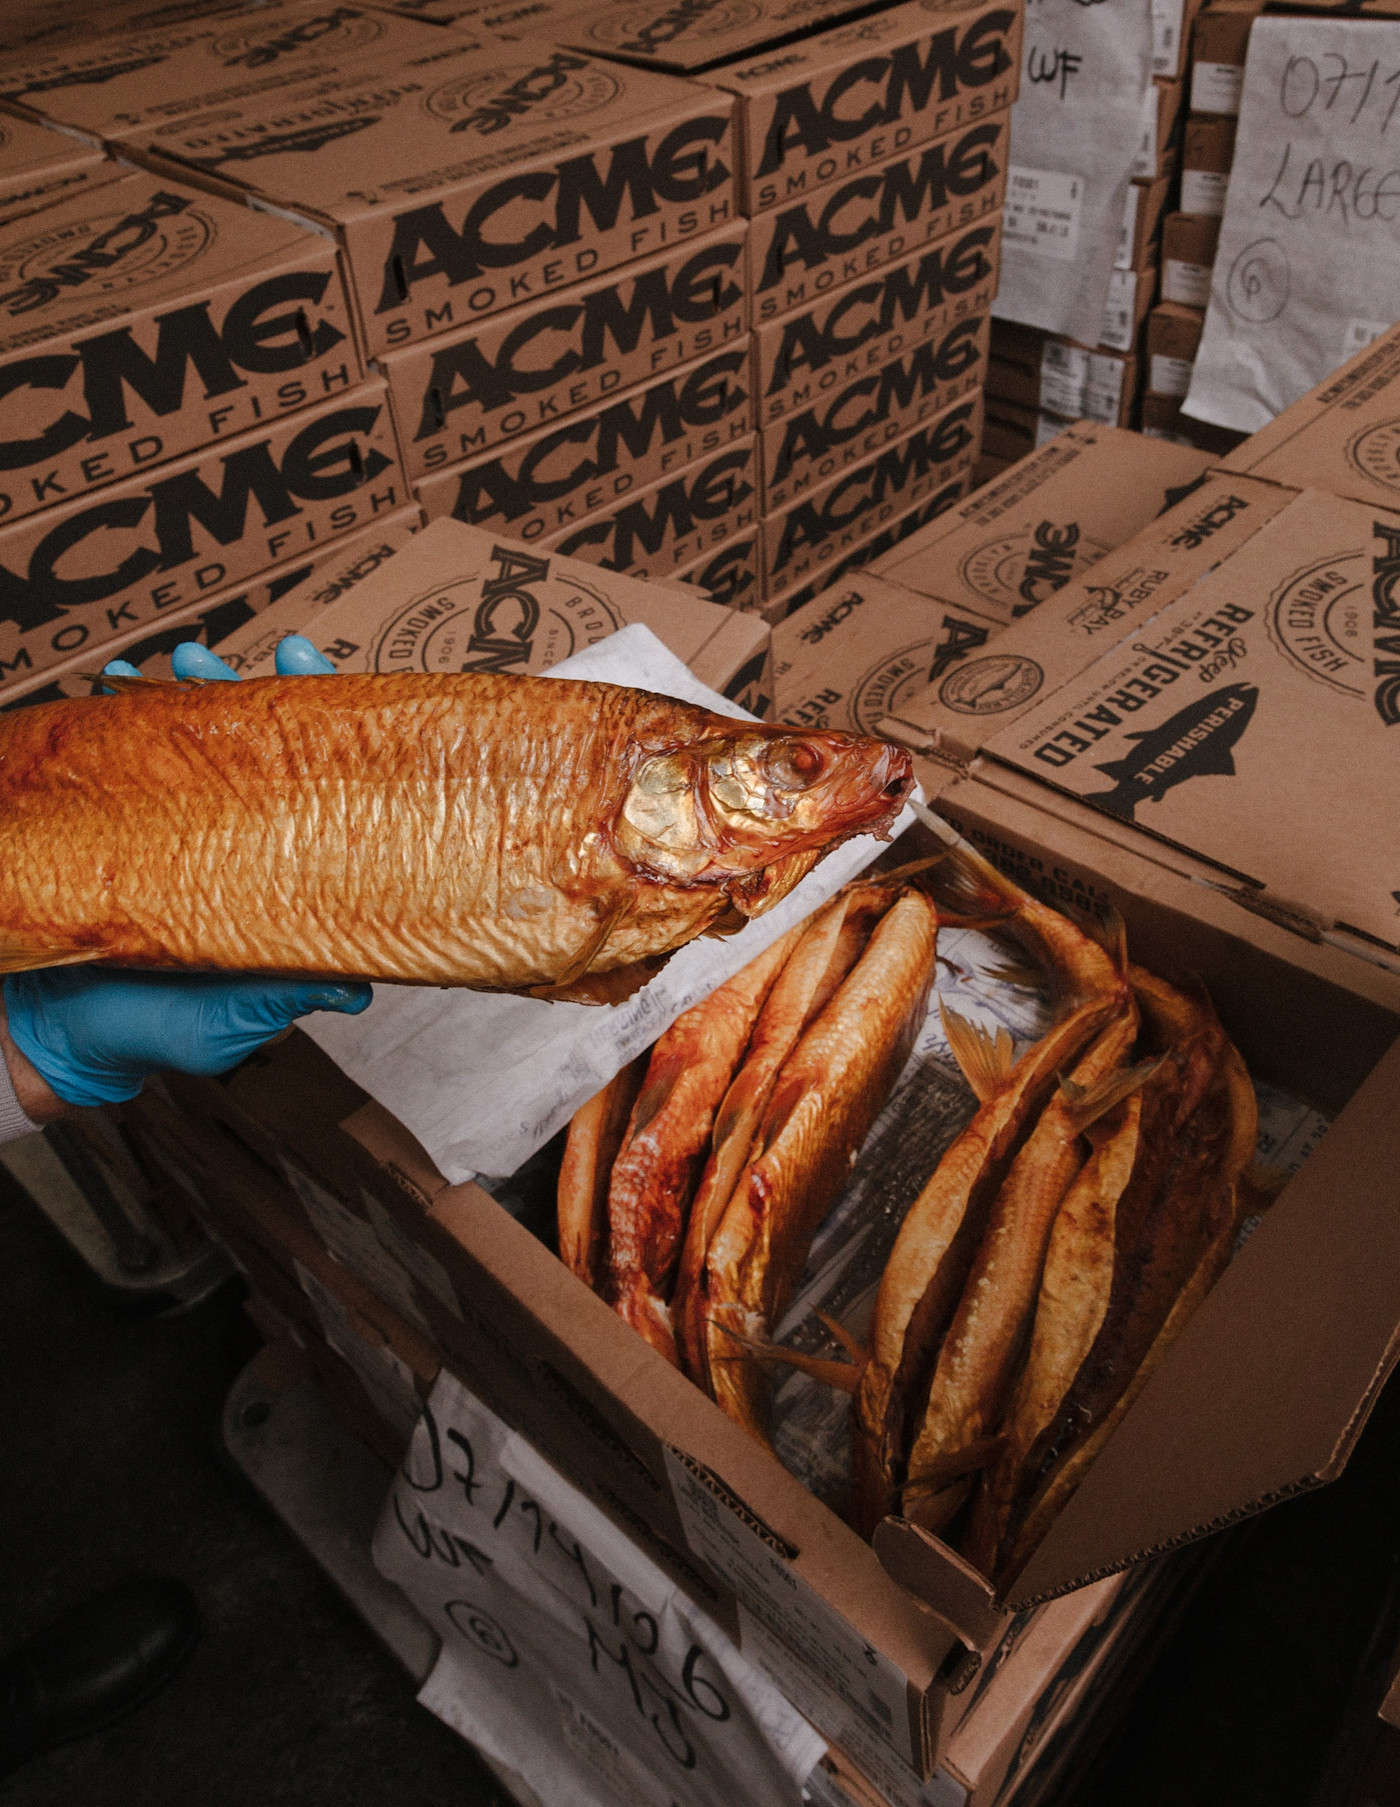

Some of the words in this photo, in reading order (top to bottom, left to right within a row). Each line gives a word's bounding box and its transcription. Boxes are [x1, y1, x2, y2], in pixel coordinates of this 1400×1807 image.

[449, 53, 591, 136] ACME
[753, 9, 1018, 181] ACME
[1027, 45, 1083, 101] WF
[759, 127, 912, 208] SMOKED
[934, 85, 1010, 133] FISH
[374, 116, 732, 315] ACME
[754, 123, 1003, 295] ACME
[760, 236, 906, 320] SMOKED
[926, 191, 997, 240] FISH
[386, 249, 599, 344] SMOKED
[630, 199, 730, 252] FISH
[764, 225, 997, 399] ACME
[0, 270, 347, 473] CME
[208, 365, 349, 435] FISH
[413, 243, 744, 443] ACME
[424, 369, 621, 468] SMOKED
[651, 315, 742, 371] FISH
[768, 316, 985, 489] ACME
[769, 334, 903, 415] SMOKED
[923, 286, 989, 333] FISH
[451, 352, 748, 526] ACME
[520, 473, 634, 541] OKED
[660, 416, 747, 472] FISH
[771, 401, 977, 577] ACME
[772, 421, 899, 507] SMOKED
[0, 562, 227, 682] MOKED
[267, 487, 396, 558] FISH
[312, 543, 397, 605] ACME
[673, 508, 752, 563] FISH
[1171, 495, 1250, 550] ACME
[388, 596, 457, 660] SMOKED
[437, 630, 457, 665] 1906
[460, 544, 551, 675] ACM
[801, 590, 865, 645] ACME
[1083, 607, 1127, 636] BAY
[1122, 569, 1170, 609] RUBY
[1287, 570, 1349, 629] SMOKED
[1032, 601, 1255, 768] REFRIGERATED
[1199, 637, 1249, 684] Keep
[1294, 635, 1351, 672] FISH
[1133, 697, 1245, 786] PERISHABLE
